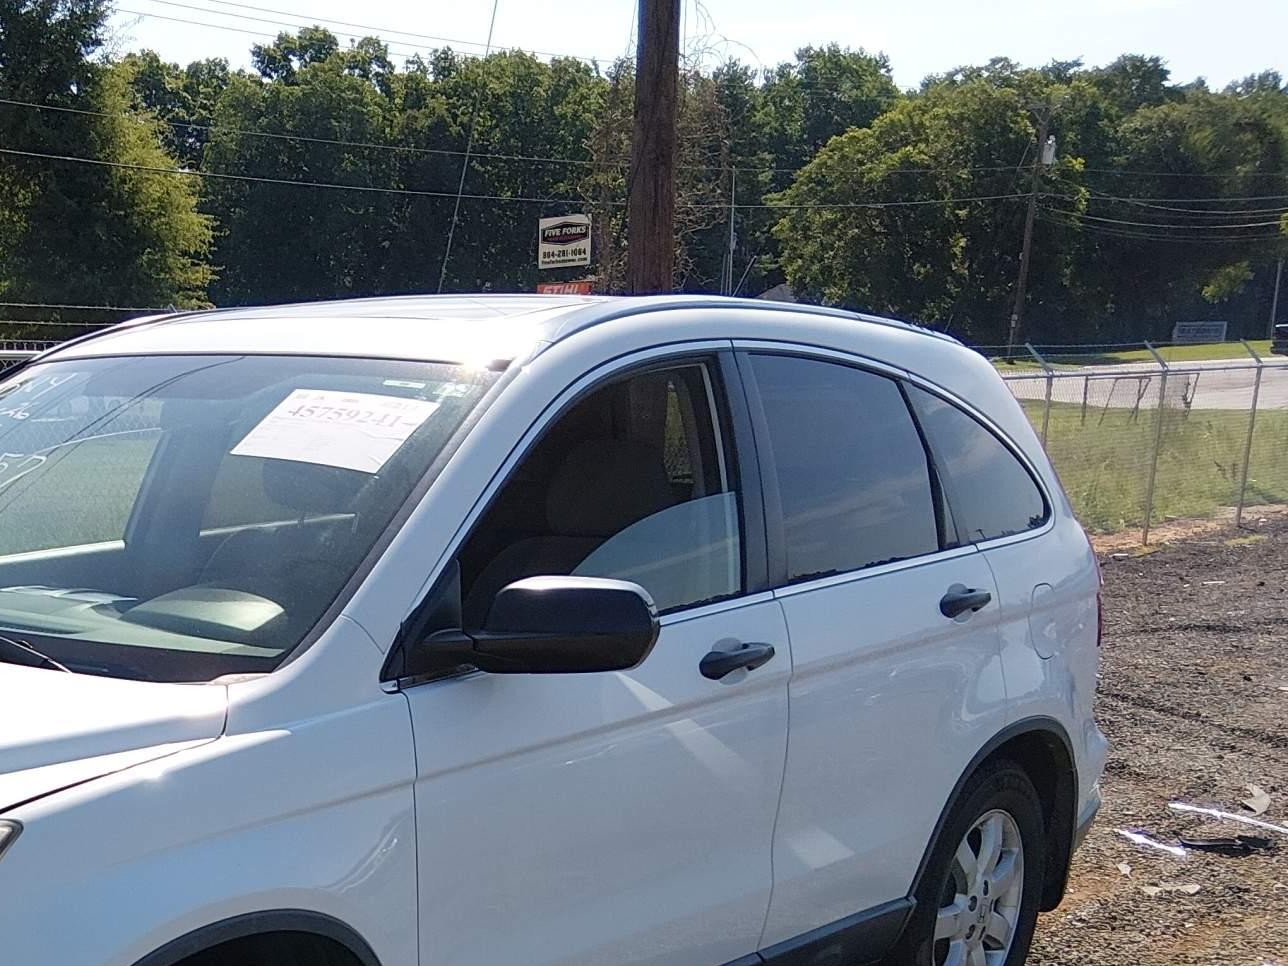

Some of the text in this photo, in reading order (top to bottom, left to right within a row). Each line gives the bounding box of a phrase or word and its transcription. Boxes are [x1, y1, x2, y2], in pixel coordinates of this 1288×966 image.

[544, 228, 562, 238] FIVE
[562, 225, 587, 235] FORKS
[288, 404, 403, 427] 45759241
